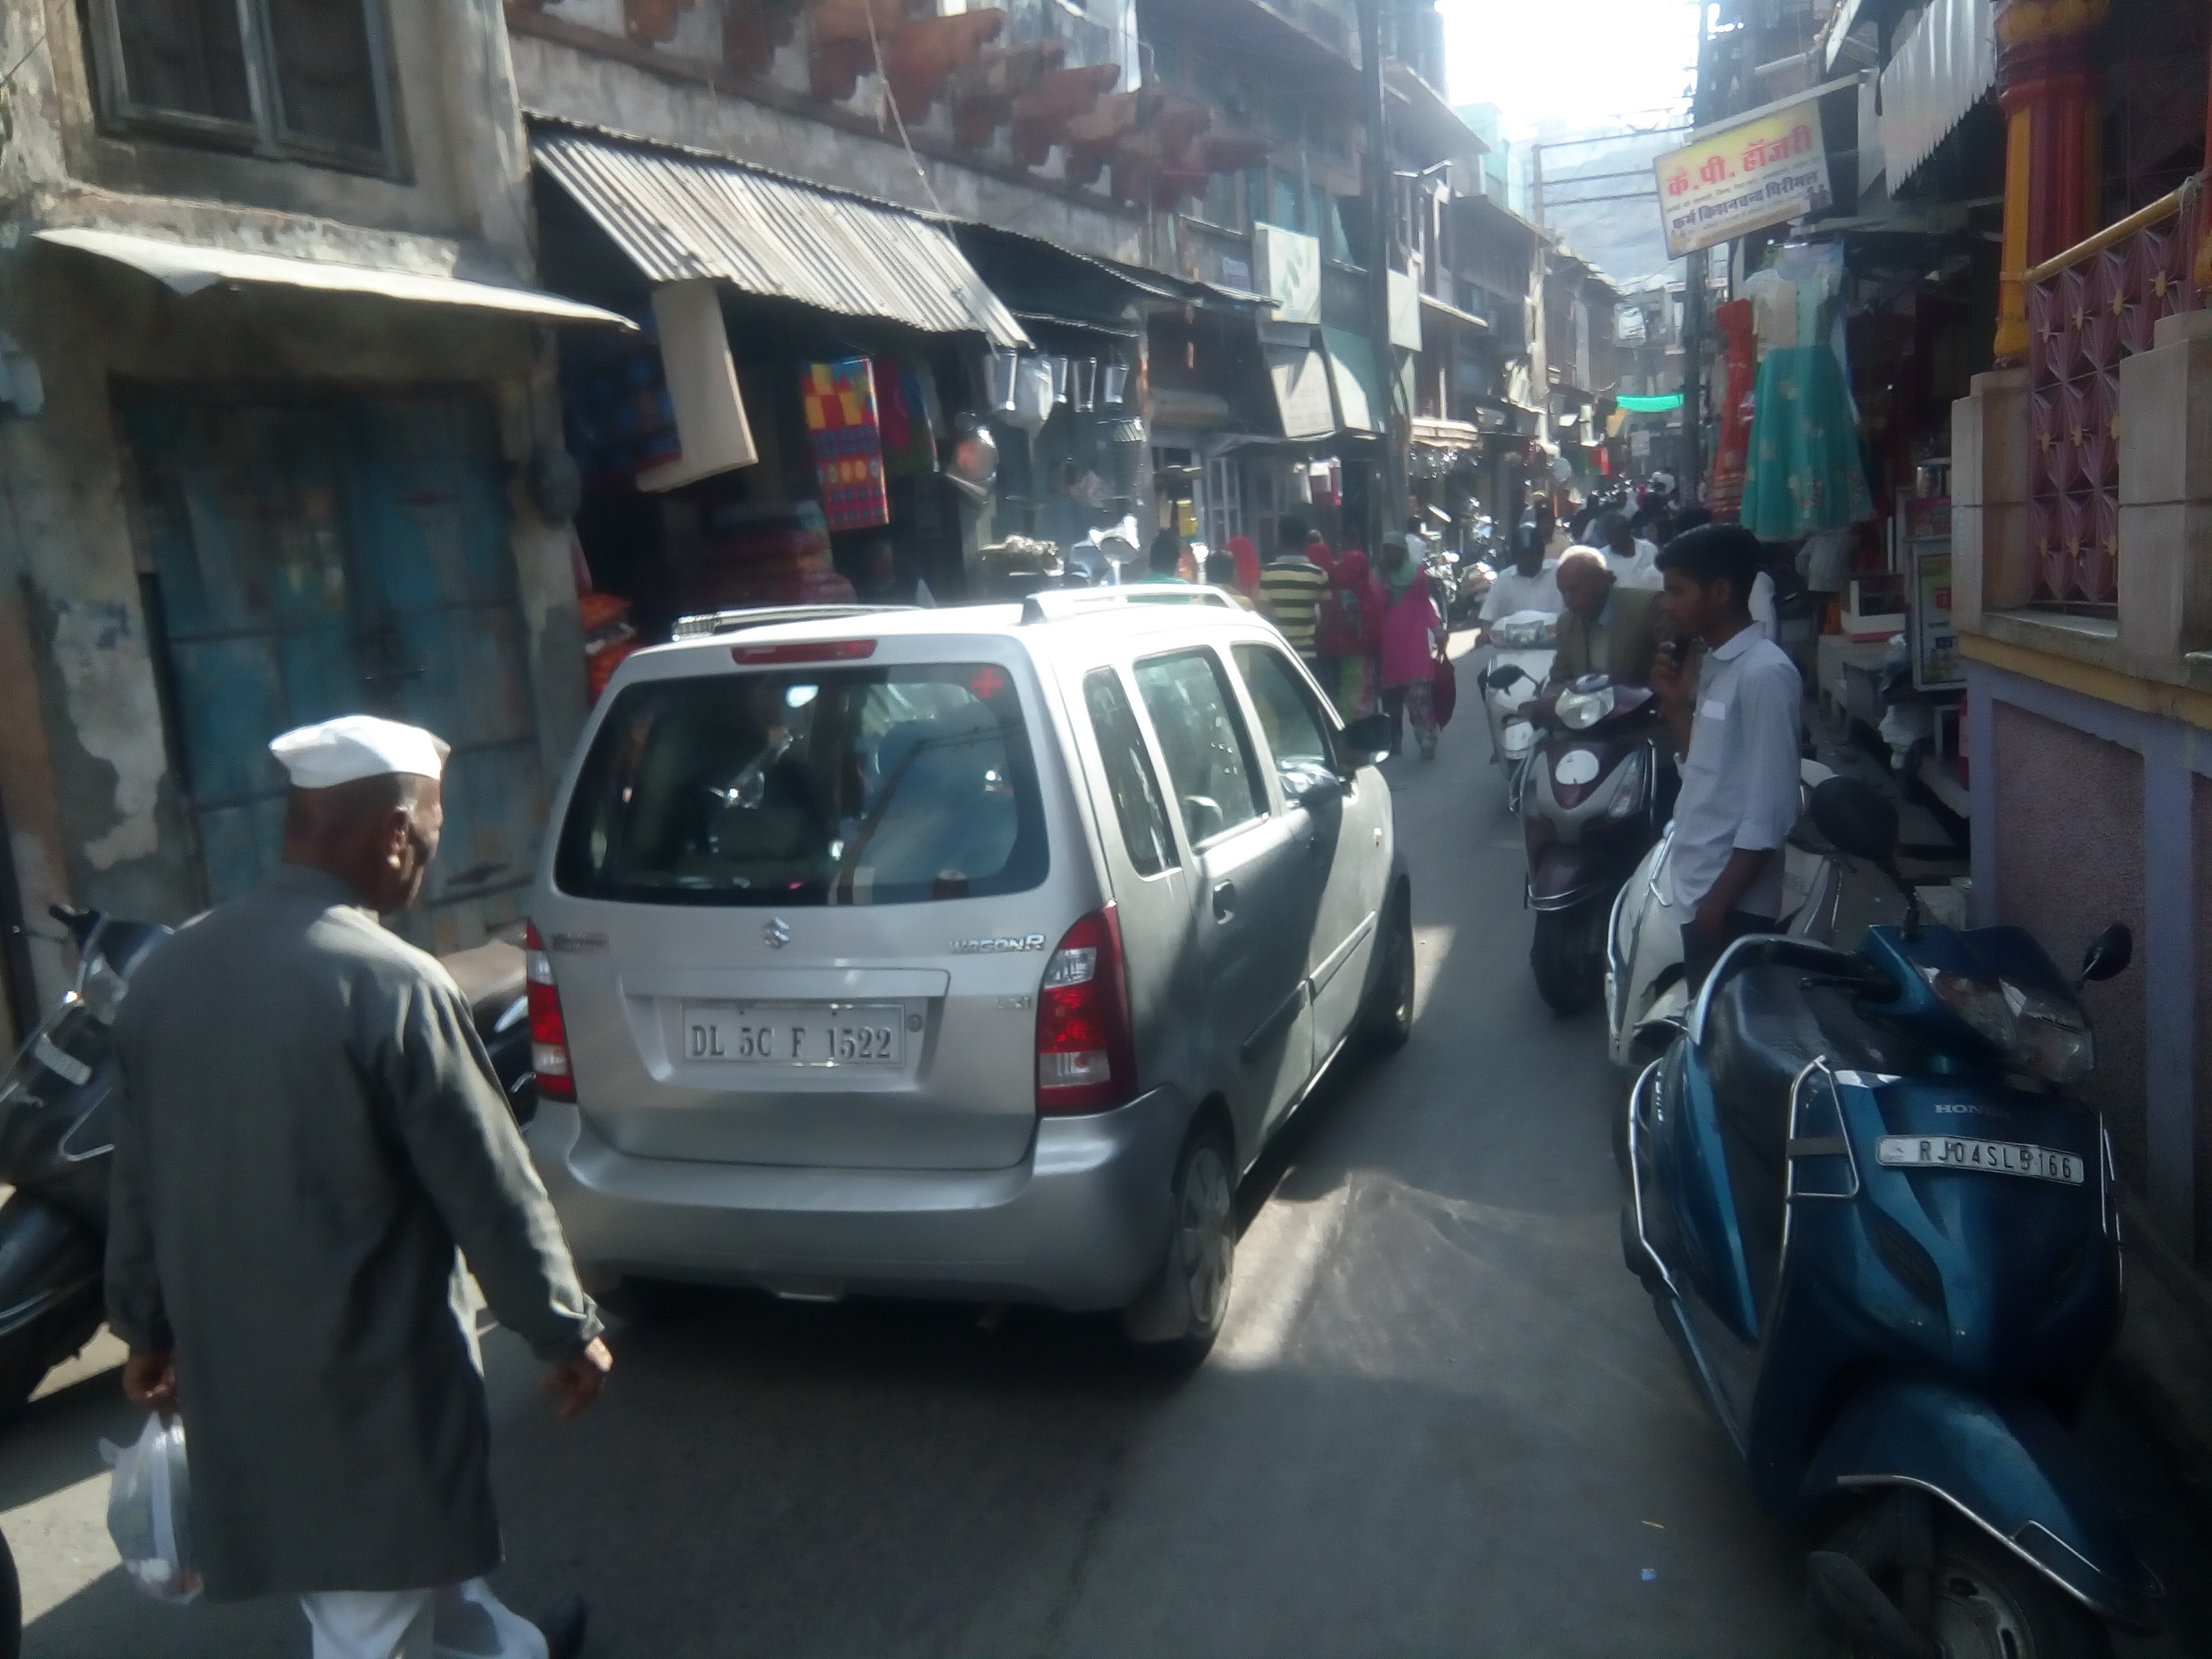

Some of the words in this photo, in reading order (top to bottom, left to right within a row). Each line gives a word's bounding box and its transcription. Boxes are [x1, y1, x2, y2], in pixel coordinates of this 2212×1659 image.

[692, 1025, 725, 1056] DL
[739, 1026, 774, 1057] 5C
[792, 1026, 806, 1057] F
[827, 1025, 892, 1059] 1522
